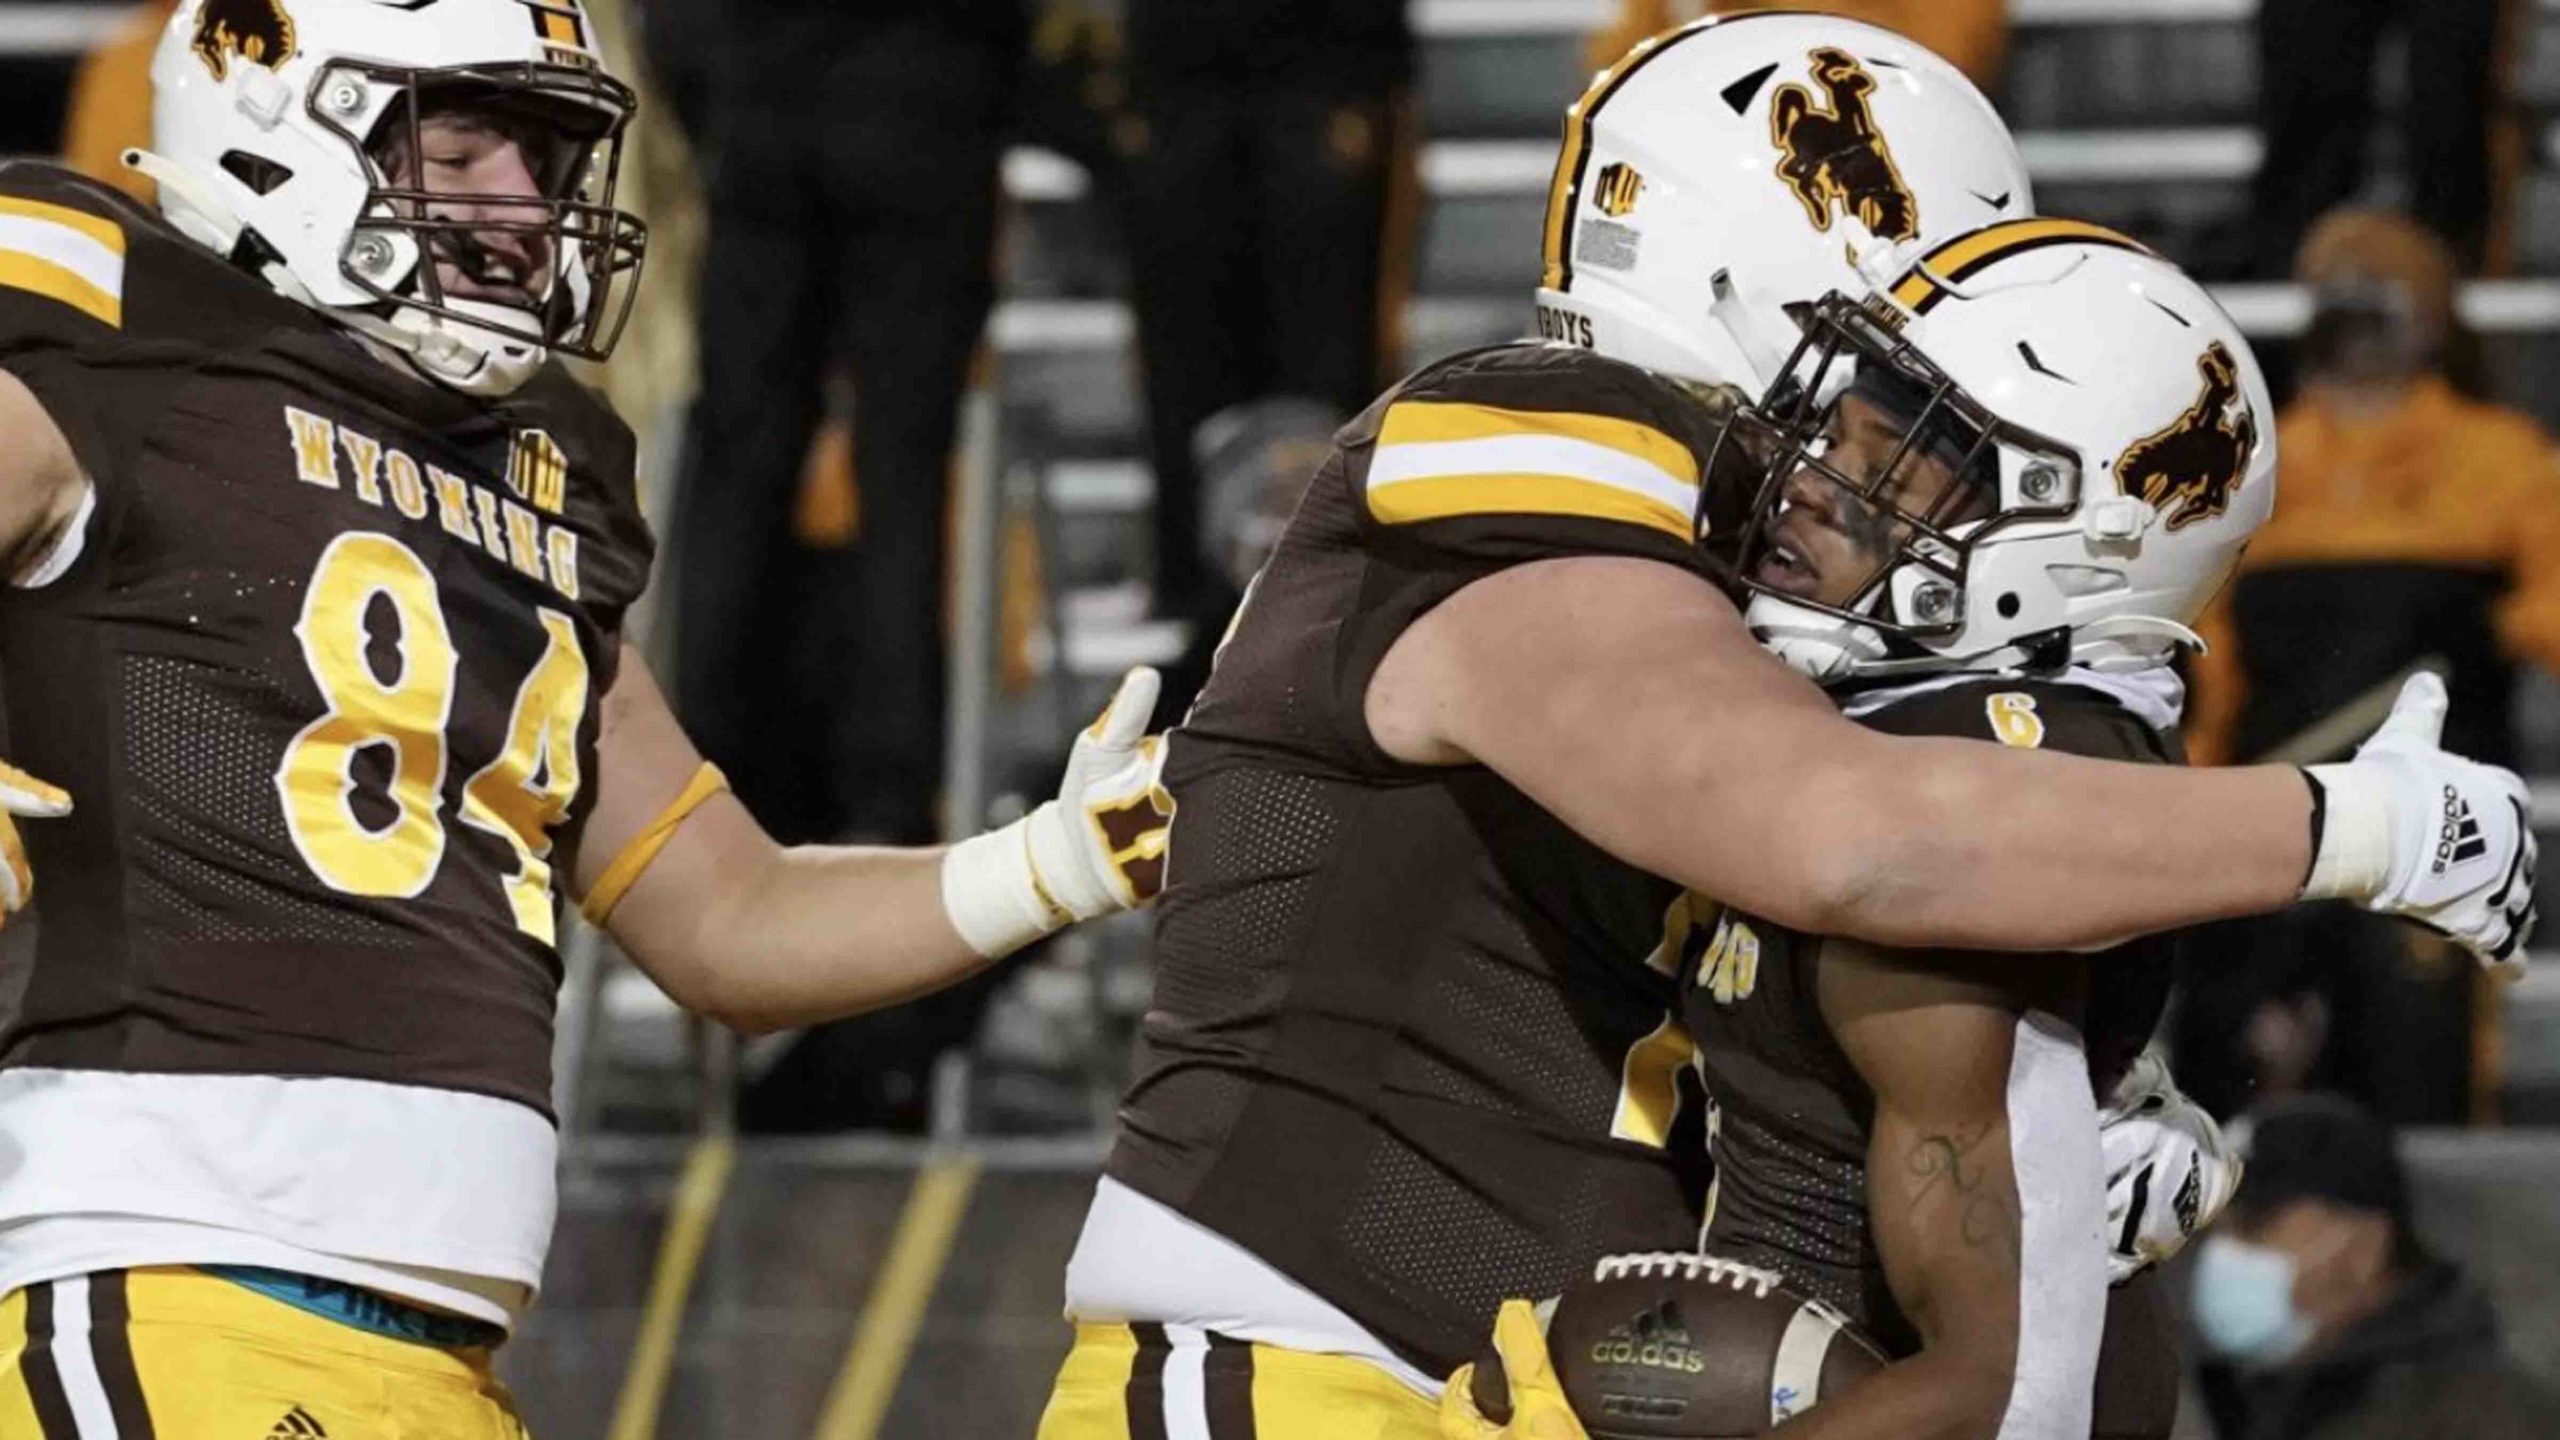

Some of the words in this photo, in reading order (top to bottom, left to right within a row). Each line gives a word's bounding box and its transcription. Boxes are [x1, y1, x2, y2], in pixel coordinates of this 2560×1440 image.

[283, 404, 580, 602] WYOMING
[273, 530, 590, 949] 84
[1985, 691, 2046, 750] 6
[2431, 783, 2462, 875] adidas
